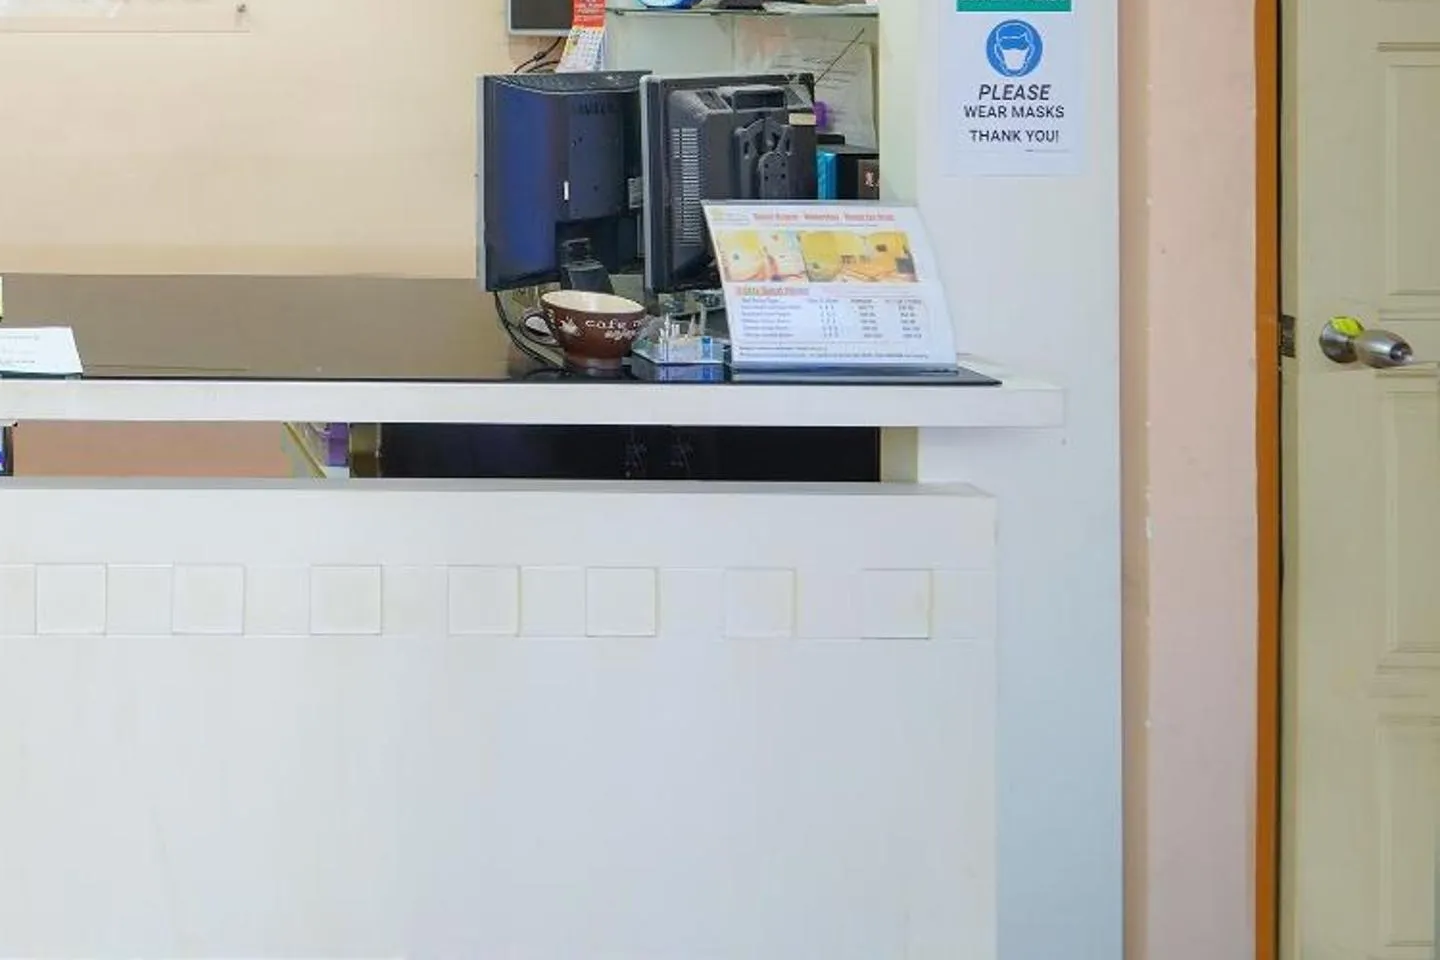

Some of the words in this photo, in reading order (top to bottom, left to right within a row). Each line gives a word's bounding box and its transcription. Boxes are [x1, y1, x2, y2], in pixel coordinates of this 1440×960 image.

[978, 83, 1052, 101] PLEASE
[963, 105, 1007, 119] WEAR
[1011, 105, 1065, 119] MASKS
[969, 129, 1022, 143] THANK
[1025, 129, 1059, 143] YOU!
